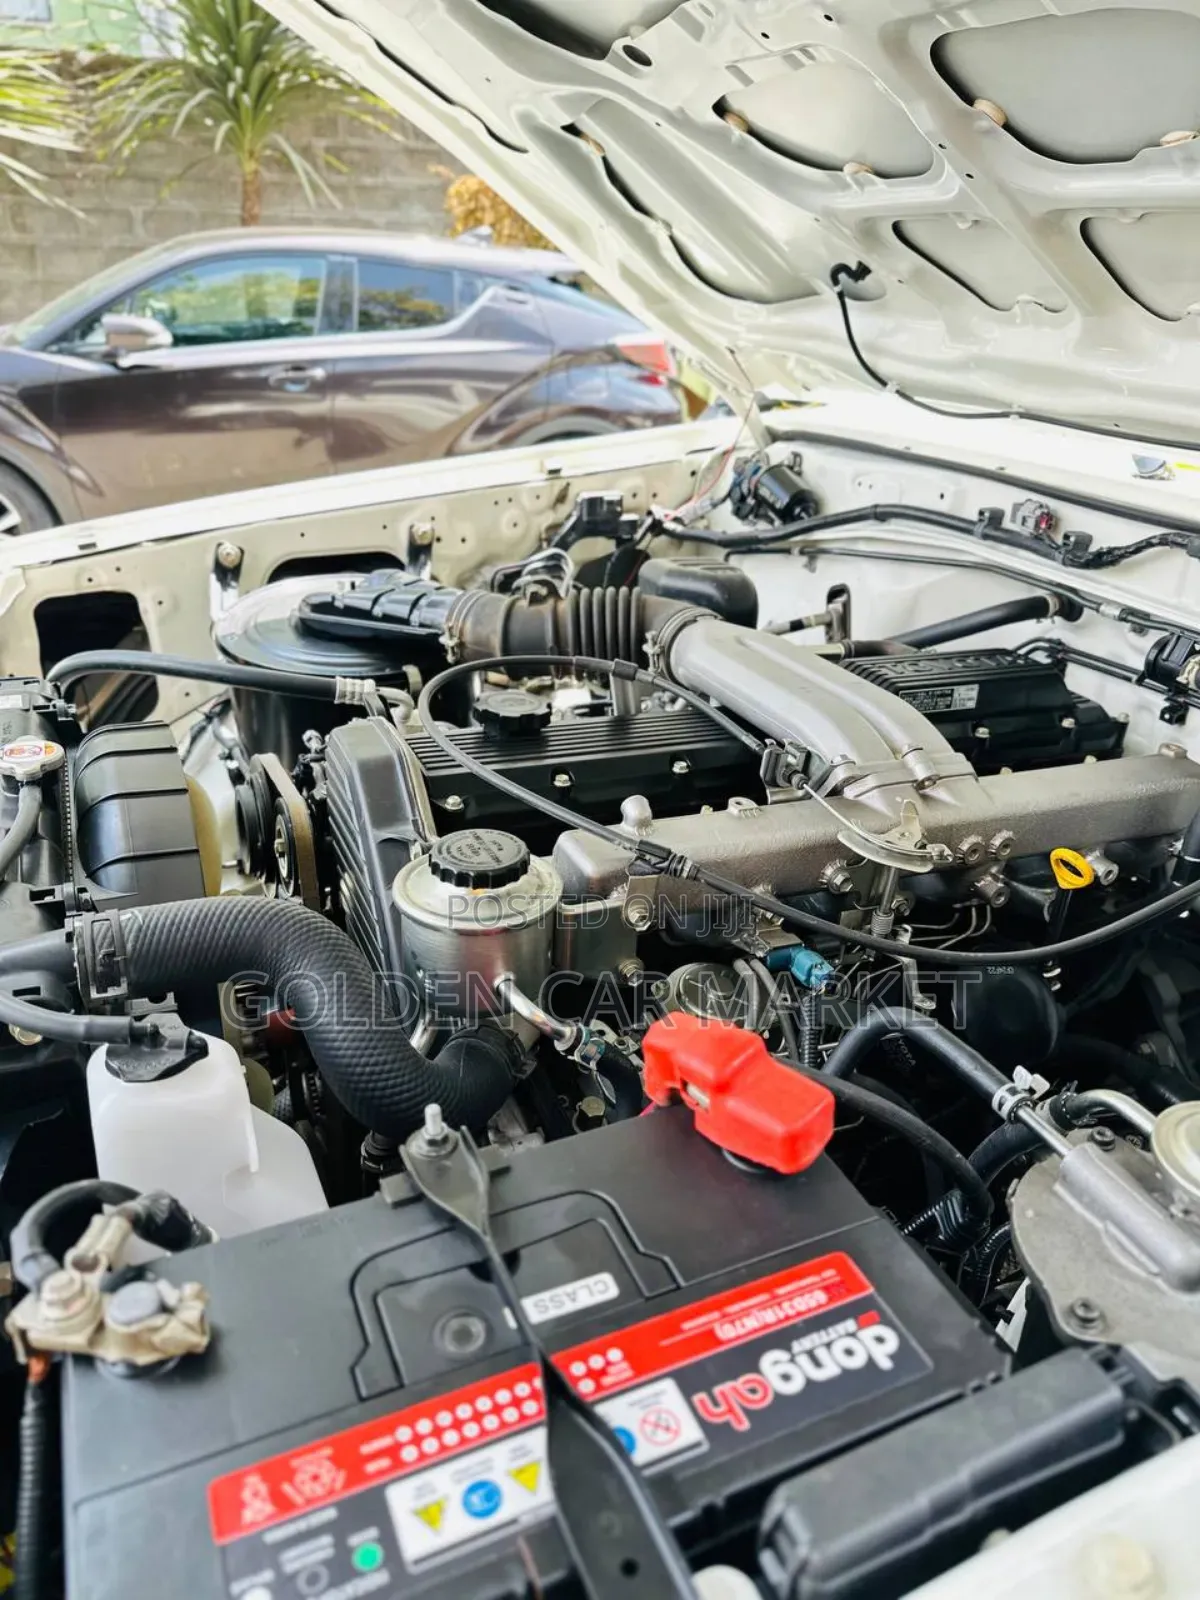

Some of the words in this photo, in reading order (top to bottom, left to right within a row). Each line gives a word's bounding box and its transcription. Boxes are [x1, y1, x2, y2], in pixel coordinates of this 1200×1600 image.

[533, 1279, 610, 1314] CLASS
[791, 1318, 858, 1355] BATTERY
[691, 1324, 900, 1432] dongah
